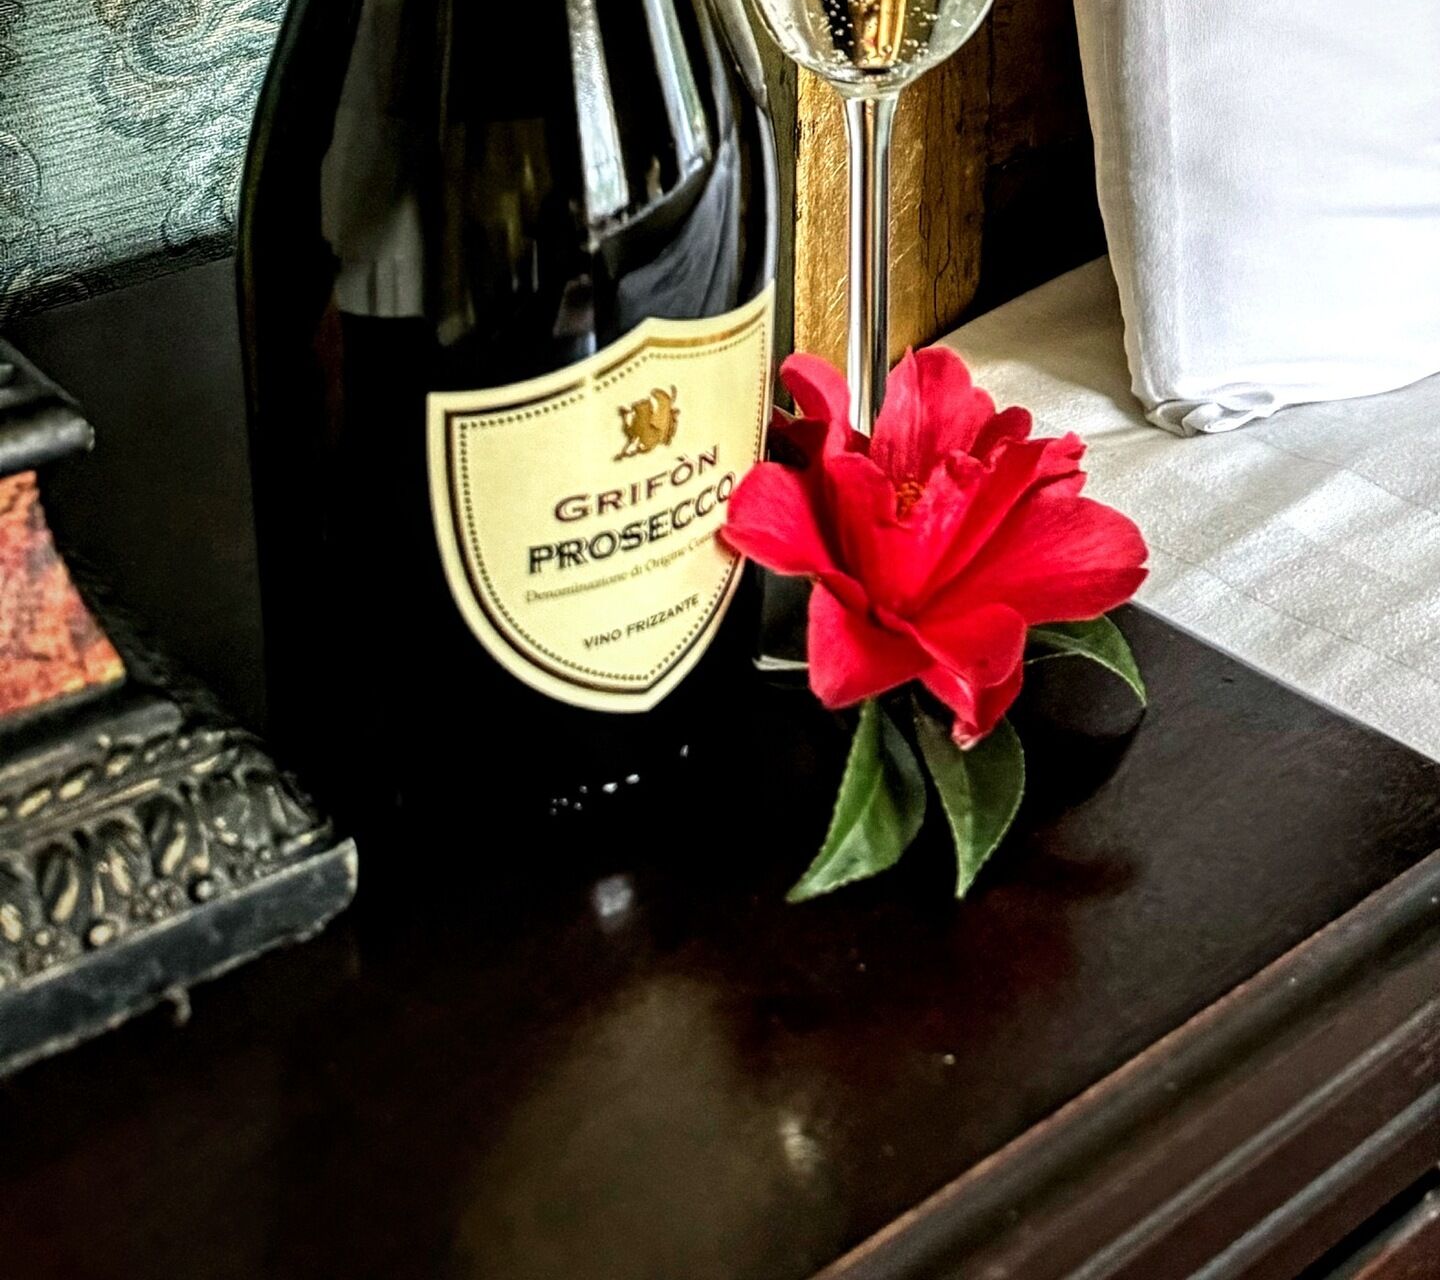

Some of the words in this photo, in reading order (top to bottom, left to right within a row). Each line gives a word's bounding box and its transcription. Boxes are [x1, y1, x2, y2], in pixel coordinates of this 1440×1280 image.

[555, 445, 719, 522] GRIFÒN
[528, 471, 735, 574] PROSECCO
[584, 628, 622, 650] VINO
[626, 593, 700, 637] FRIZZANTE
